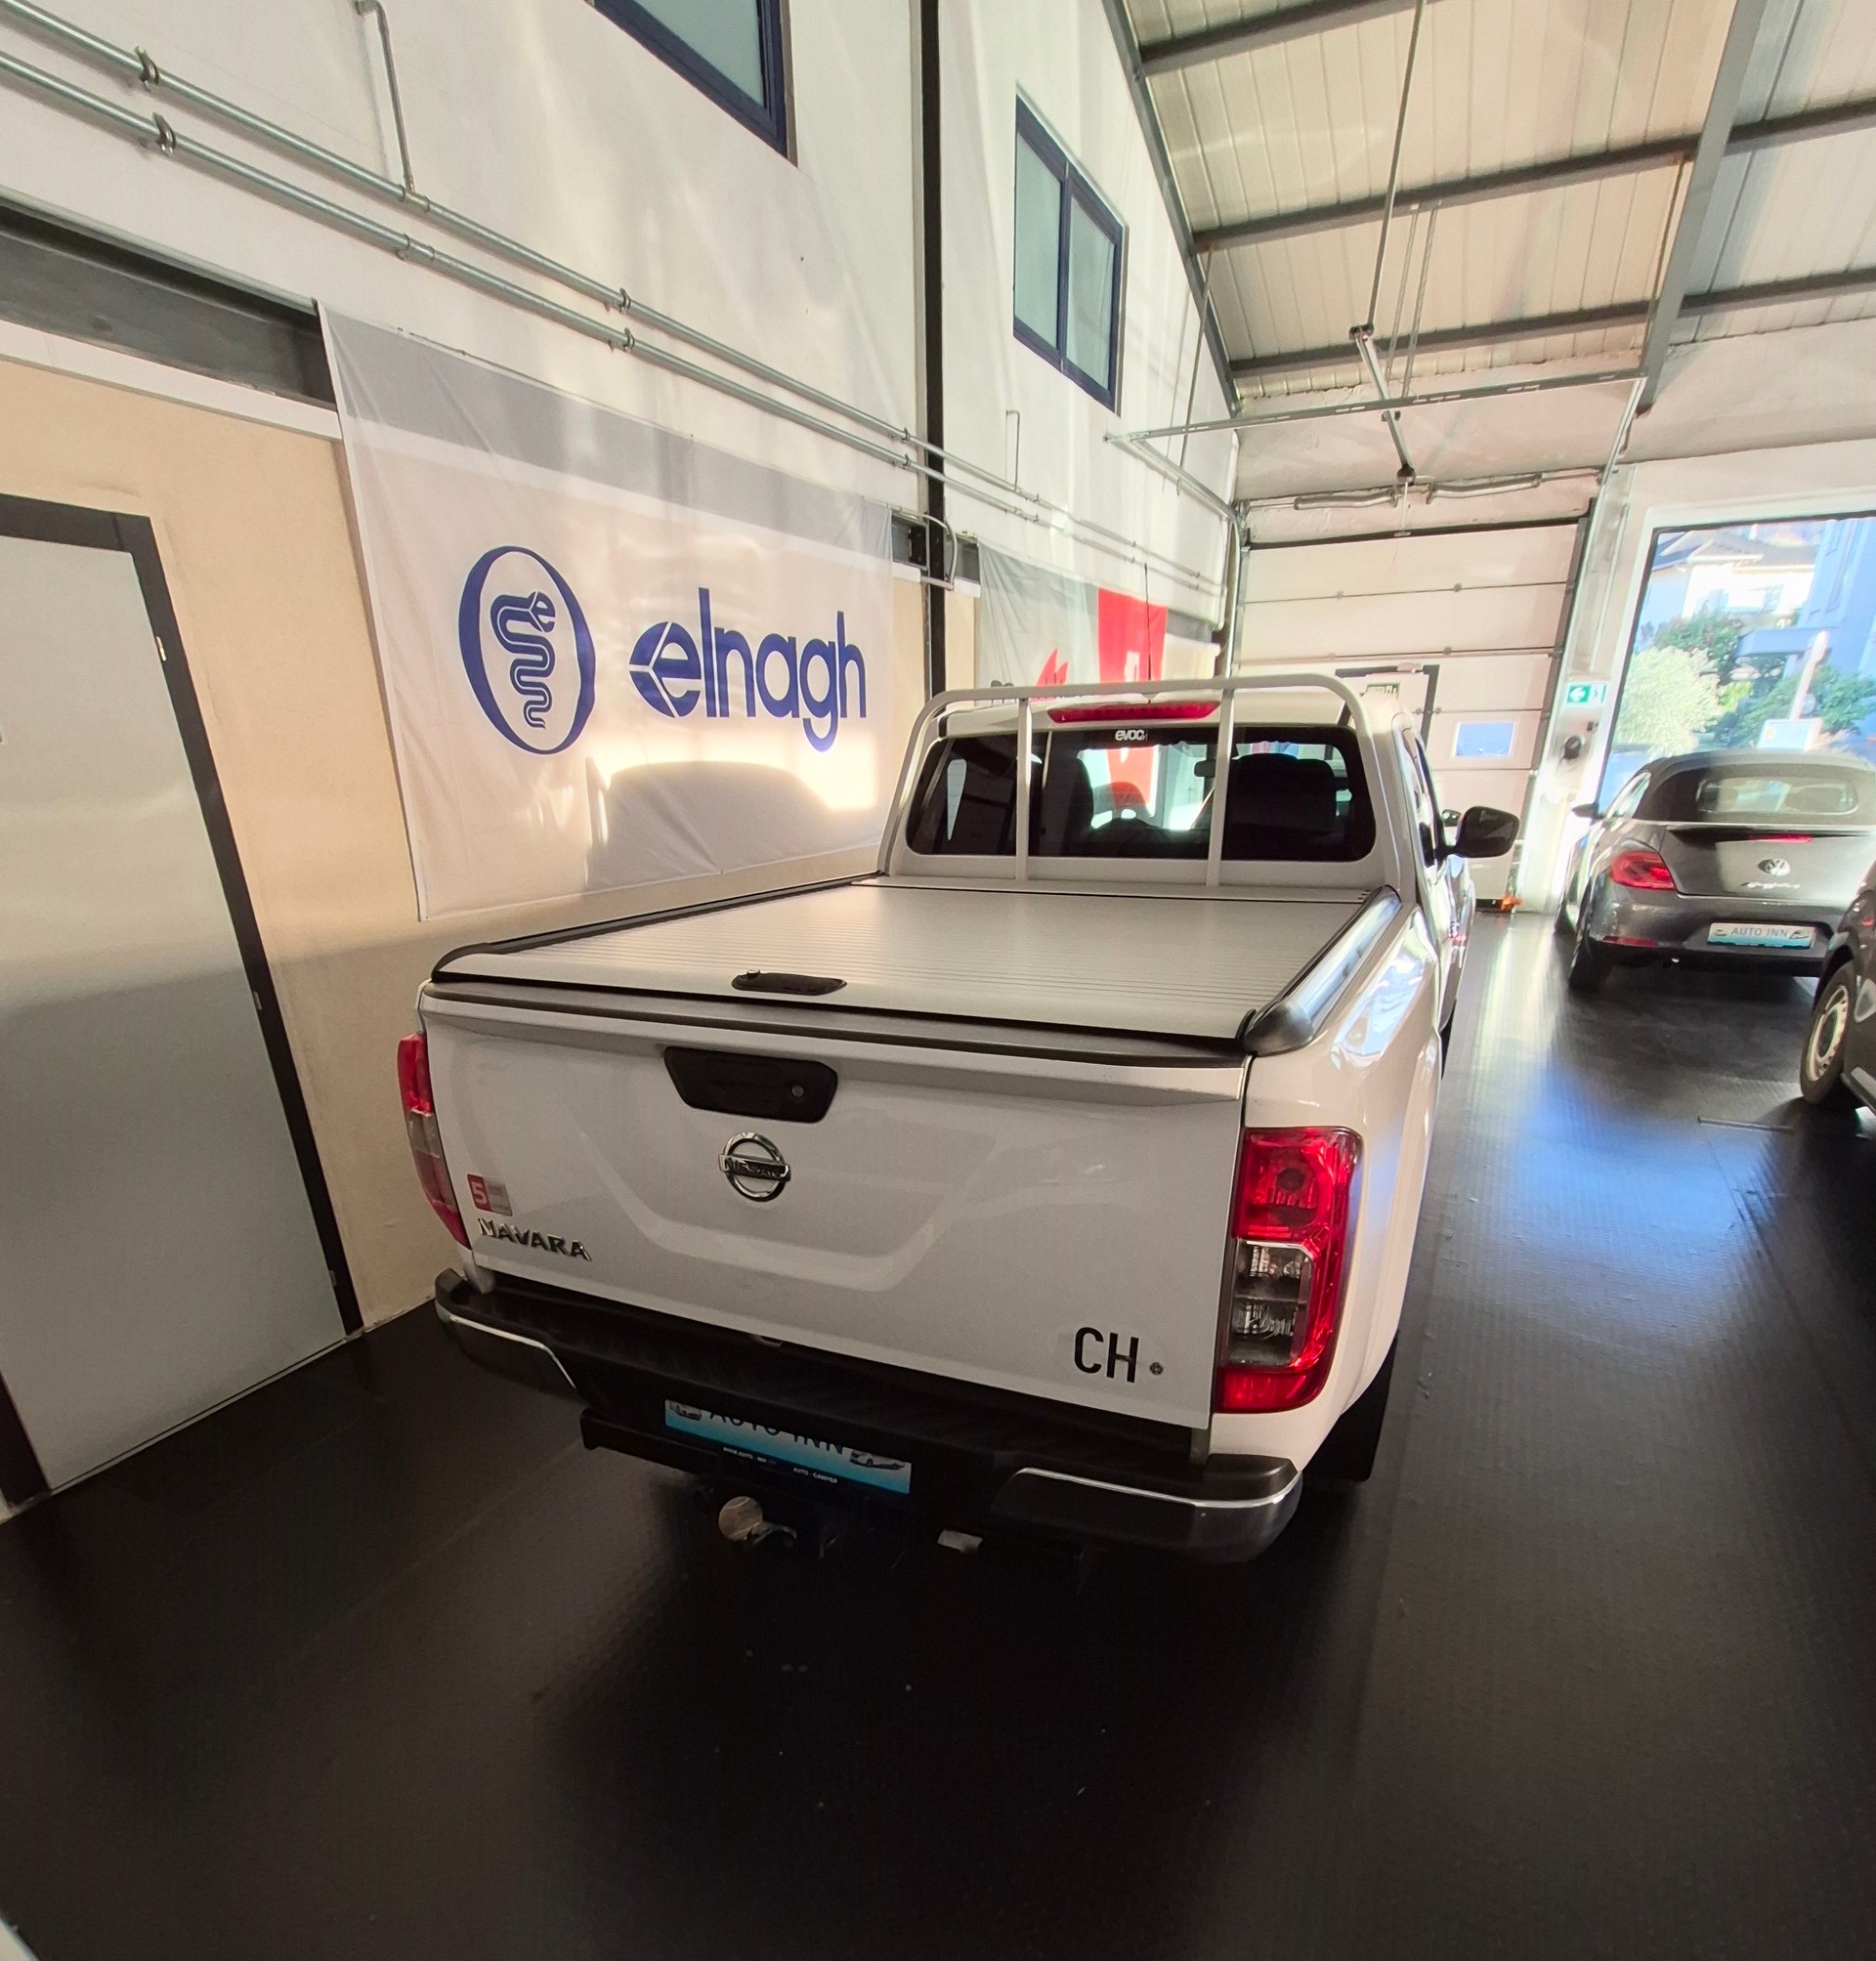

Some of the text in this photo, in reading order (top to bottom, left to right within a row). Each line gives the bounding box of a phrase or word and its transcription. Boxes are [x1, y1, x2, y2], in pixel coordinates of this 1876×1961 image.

[628, 586, 867, 752] elnagh
[1730, 927, 1763, 936] AUTO
[477, 1217, 593, 1261] NAVARA
[1074, 1327, 1139, 1384] CH
